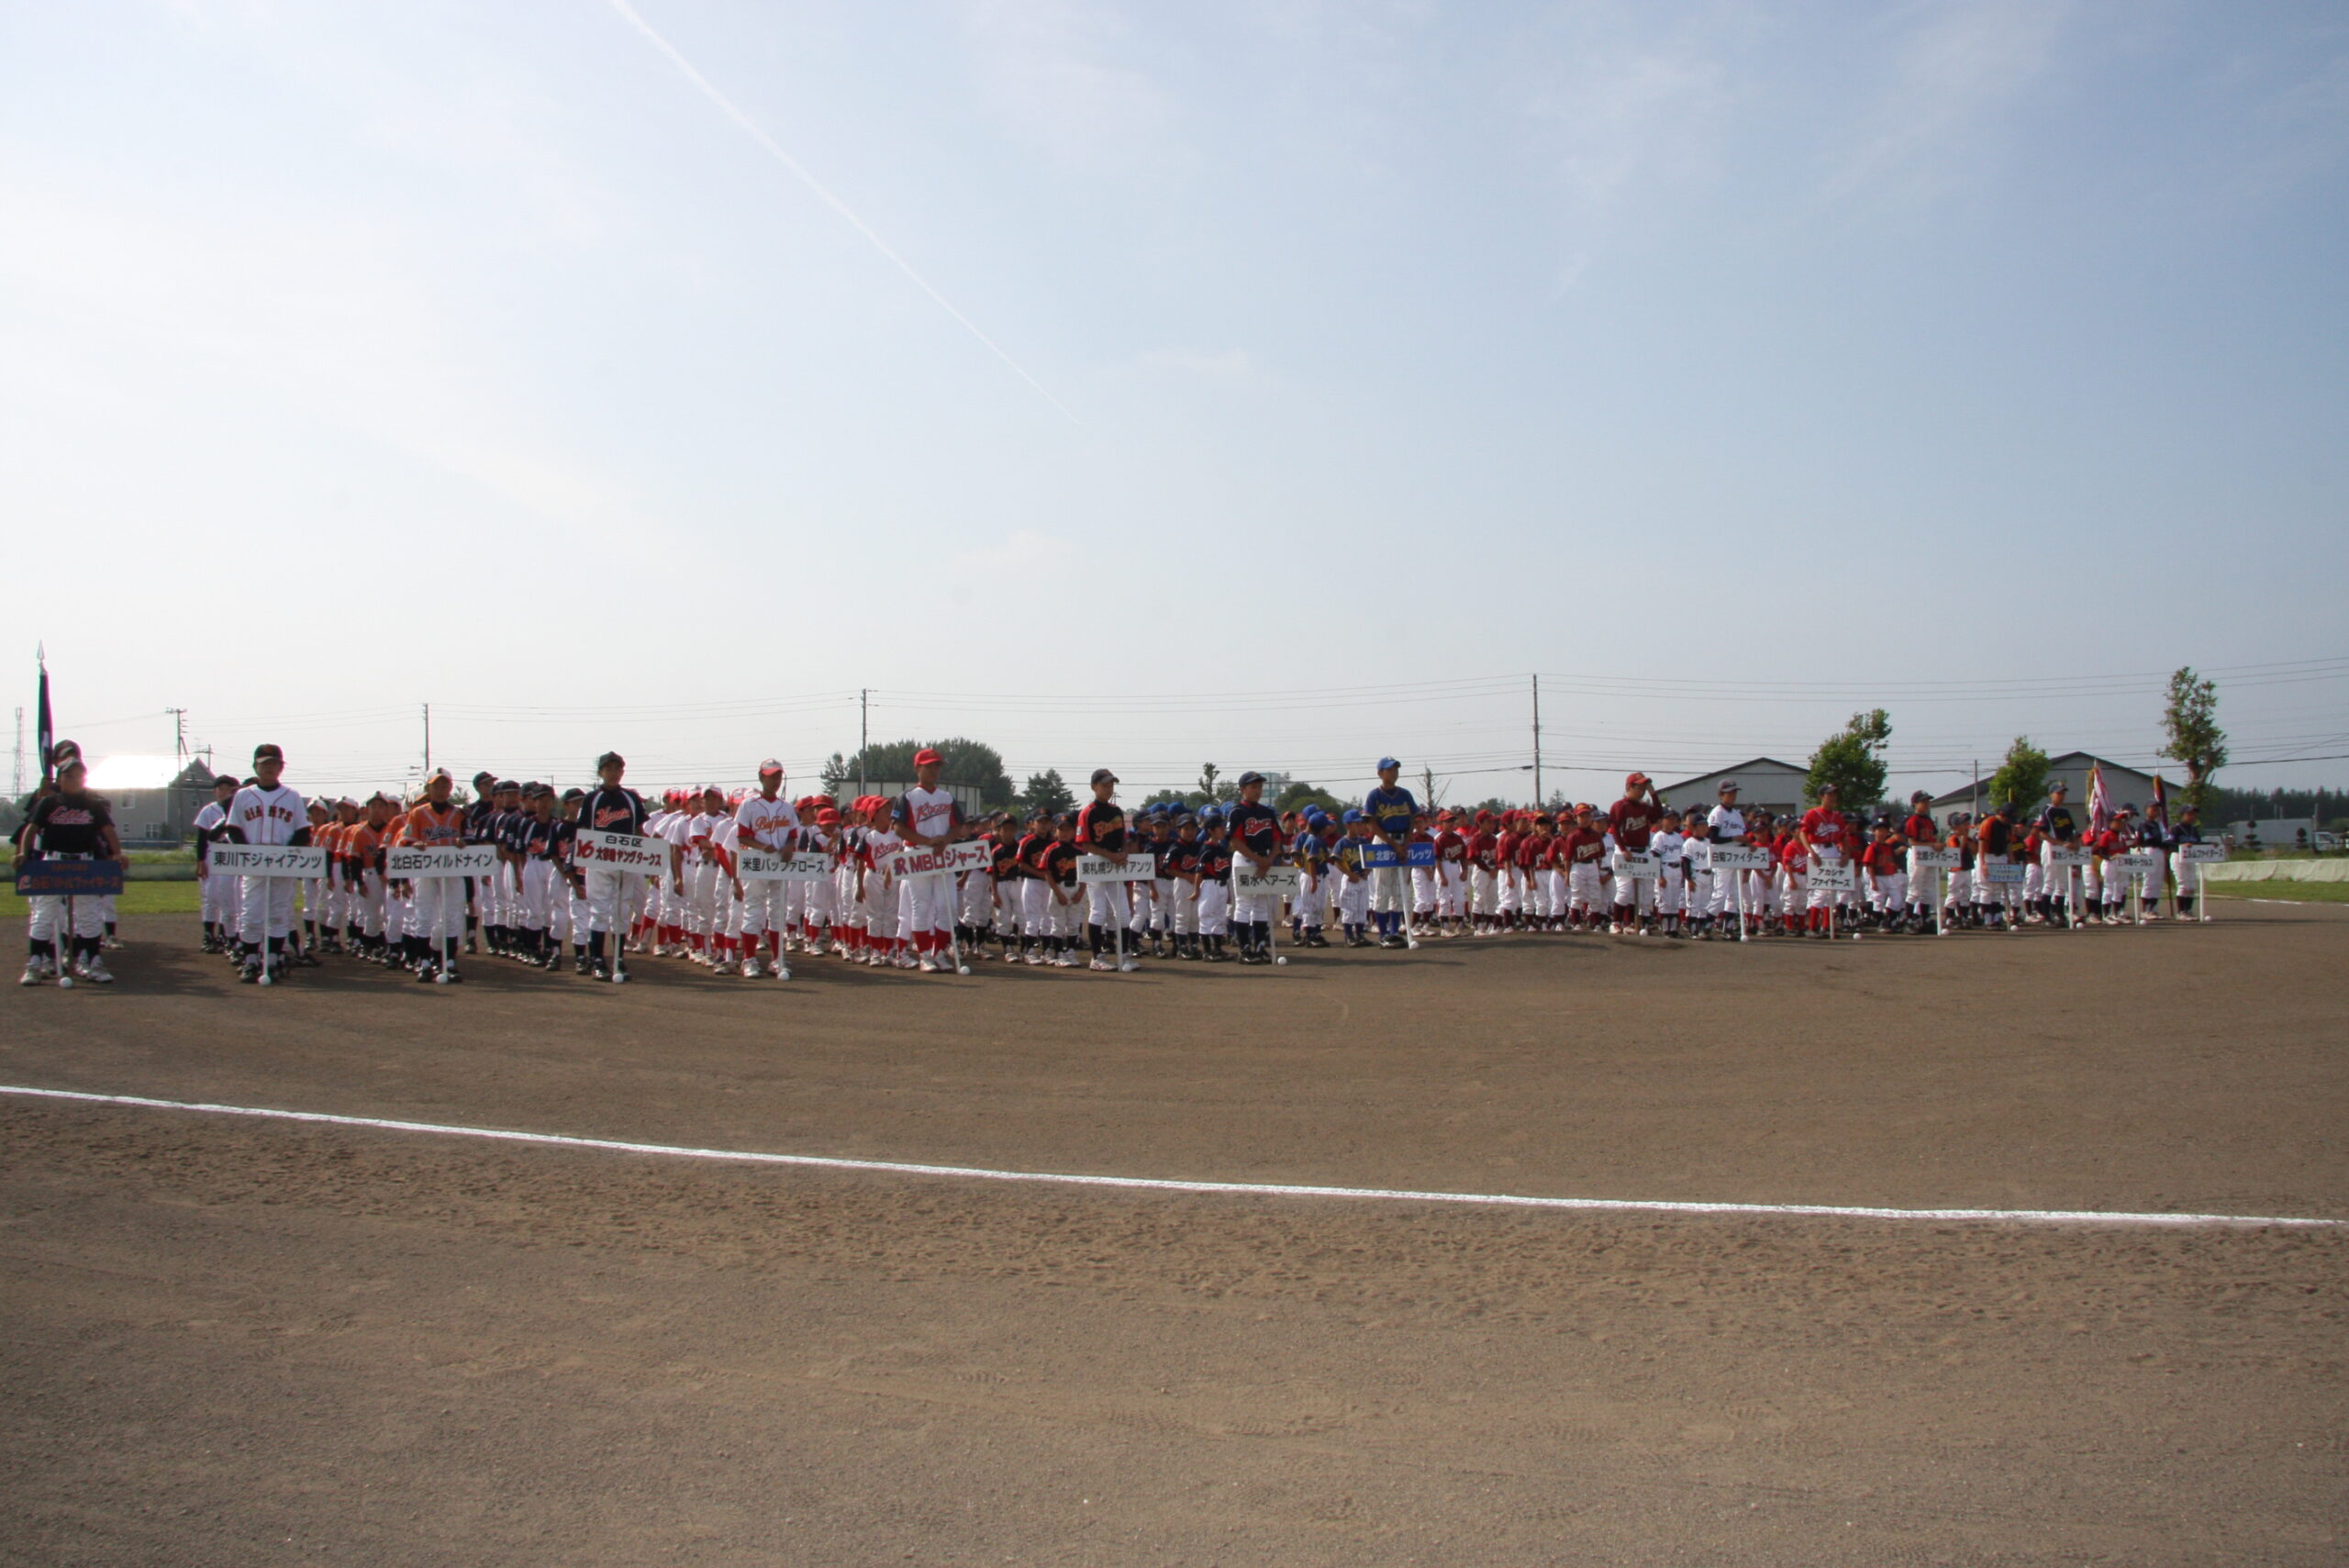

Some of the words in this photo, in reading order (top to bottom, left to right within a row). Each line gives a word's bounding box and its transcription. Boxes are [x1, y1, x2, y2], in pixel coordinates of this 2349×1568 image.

[606, 834, 643, 848] 白石区
[214, 851, 323, 869] 東川下ジャイアンツ
[391, 853, 493, 871] 北白石ワイルドナイン
[742, 857, 826, 873] 米里バッファローズ
[1082, 861, 1152, 875] 東札幌ジャイアンツ
